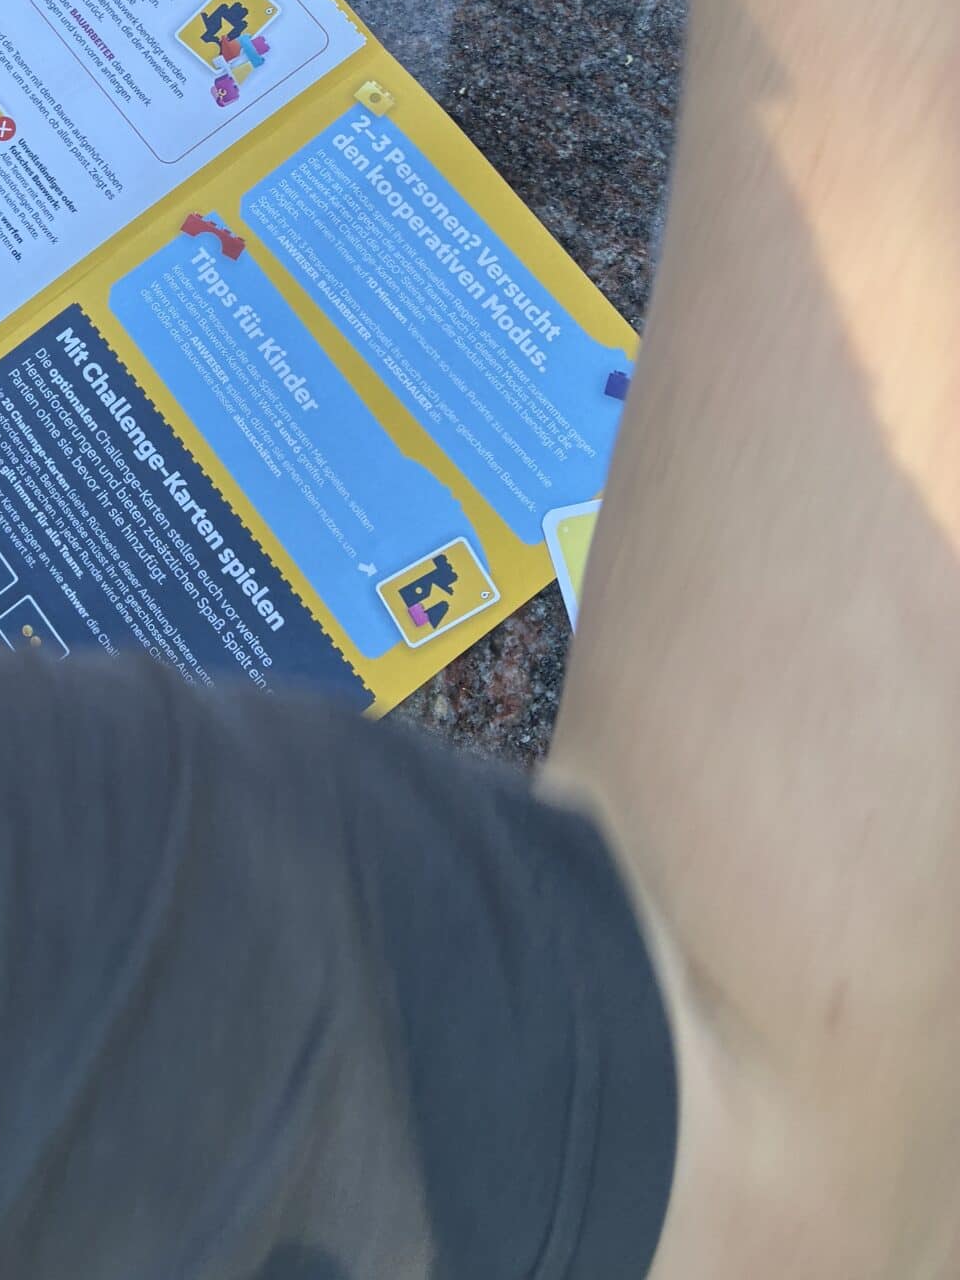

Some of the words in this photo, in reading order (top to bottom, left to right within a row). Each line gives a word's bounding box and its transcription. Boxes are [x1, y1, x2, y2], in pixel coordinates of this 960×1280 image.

[69, 7, 116, 62] BAUARBEITER
[111, 60, 126, 75] das
[122, 72, 152, 107] Bauwerk
[8, 144, 35, 177] falsches
[17, 137, 64, 197] Unvollständiges
[61, 195, 78, 213] oder
[332, 133, 370, 172] den
[365, 165, 486, 300] kooperativen
[190, 246, 238, 308] Tipps
[232, 304, 265, 340] für
[257, 336, 319, 411] Kinder
[476, 246, 561, 343] Versucht
[0, 441, 20, 465] ohne
[7, 368, 40, 410] Partien
[35, 408, 61, 439] ohne
[71, 455, 101, 492] bevor
[95, 489, 113, 509] ihr
[107, 507, 125, 527] sie
[15, 463, 27, 477] zu
[55, 326, 90, 367] Mit
[82, 362, 224, 551] Challenge-Karten
[217, 547, 285, 632] spielen
[0, 465, 17, 484] gilt
[12, 479, 39, 513] immer
[34, 511, 49, 528] für
[44, 527, 62, 548] alle
[1, 397, 15, 412] 20
[10, 409, 71, 492] Challenge-Karten
[66, 488, 90, 518] (siehe
[86, 515, 121, 561] Rückseite
[117, 560, 142, 589] dieser
[172, 633, 198, 667] bieten
[9, 532, 28, 556] wert
[21, 357, 102, 467] Herausforderungen
[98, 464, 123, 490] und
[115, 486, 147, 528] bieten
[142, 525, 200, 600] zusätzlichen
[221, 631, 253, 670] Spielt
[34, 347, 53, 369] Die
[48, 368, 99, 432] optionalen
[95, 429, 171, 530] Challenge-Karten
[166, 528, 201, 571] stellen
[197, 569, 224, 602] euch
[220, 598, 240, 621] vor
[235, 619, 273, 668] weitere
[55, 516, 65, 529] In
[58, 526, 83, 552] jeder
[0, 496, 21, 523] Karte
[16, 520, 42, 553] zeigen
[48, 564, 64, 584] wie
[60, 582, 90, 619] schwer
[86, 618, 101, 635] die
[39, 473, 89, 539] Beispielsweise
[85, 538, 109, 567] müsst
[105, 563, 118, 579] ihr
[114, 578, 130, 596] mit
[124, 594, 179, 664] geschlossenen
[79, 550, 104, 583] Runde
[100, 580, 121, 604] wird
[115, 602, 134, 624] eine
[129, 622, 151, 648] neue
